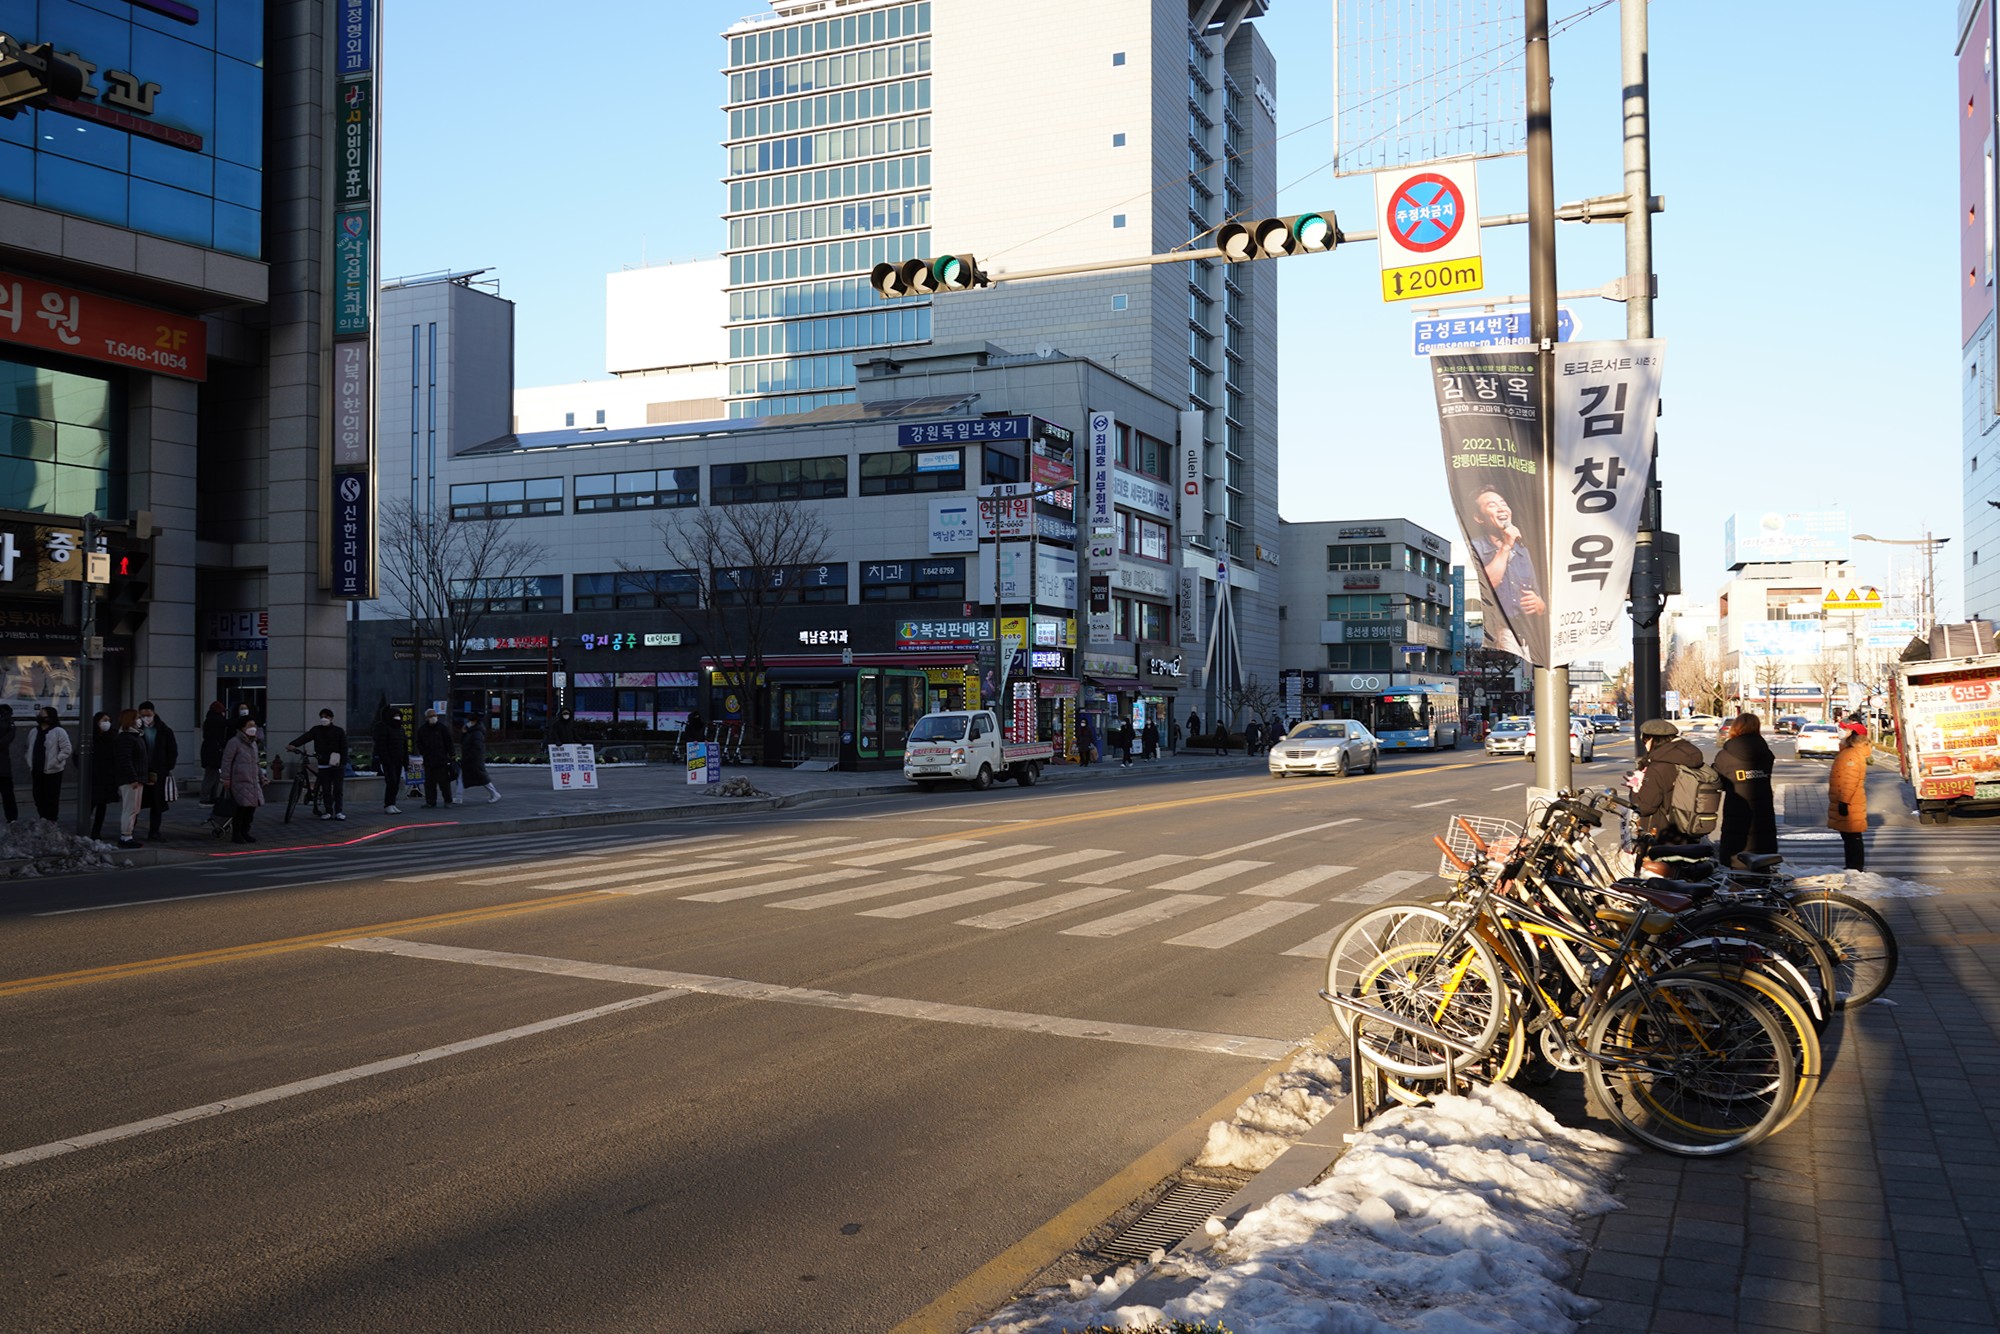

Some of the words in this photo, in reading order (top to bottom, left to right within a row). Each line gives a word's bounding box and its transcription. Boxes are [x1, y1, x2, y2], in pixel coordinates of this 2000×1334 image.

[1397, 203, 1453, 223] 주정차금지
[1409, 267, 1476, 290] 200m
[340, 318, 364, 329] 의원
[1418, 316, 1519, 340] 금성로14번길
[155, 326, 188, 350] 2F
[104, 339, 188, 370] T.646-1054
[1563, 358, 1632, 376] 토크콘서트
[343, 348, 360, 448] 거북이한의원
[911, 421, 1018, 443] 강원독일보청기
[1096, 433, 1106, 467] 최태호
[1187, 450, 1198, 479] olleh
[1452, 454, 1506, 469] 강릉아트센터
[1096, 471, 1106, 515] 세무회계
[343, 505, 357, 592] 신한라이프
[869, 565, 904, 581] 치과
[646, 634, 679, 644] 네일아트
[799, 630, 848, 645] 백남운치과
[920, 621, 989, 638] 복권판매점
[1346, 626, 1369, 638] 홍선생
[581, 633, 637, 650] 엄지공주
[1955, 685, 1987, 700] 5년근
[1927, 780, 1973, 796] 금산인삼
